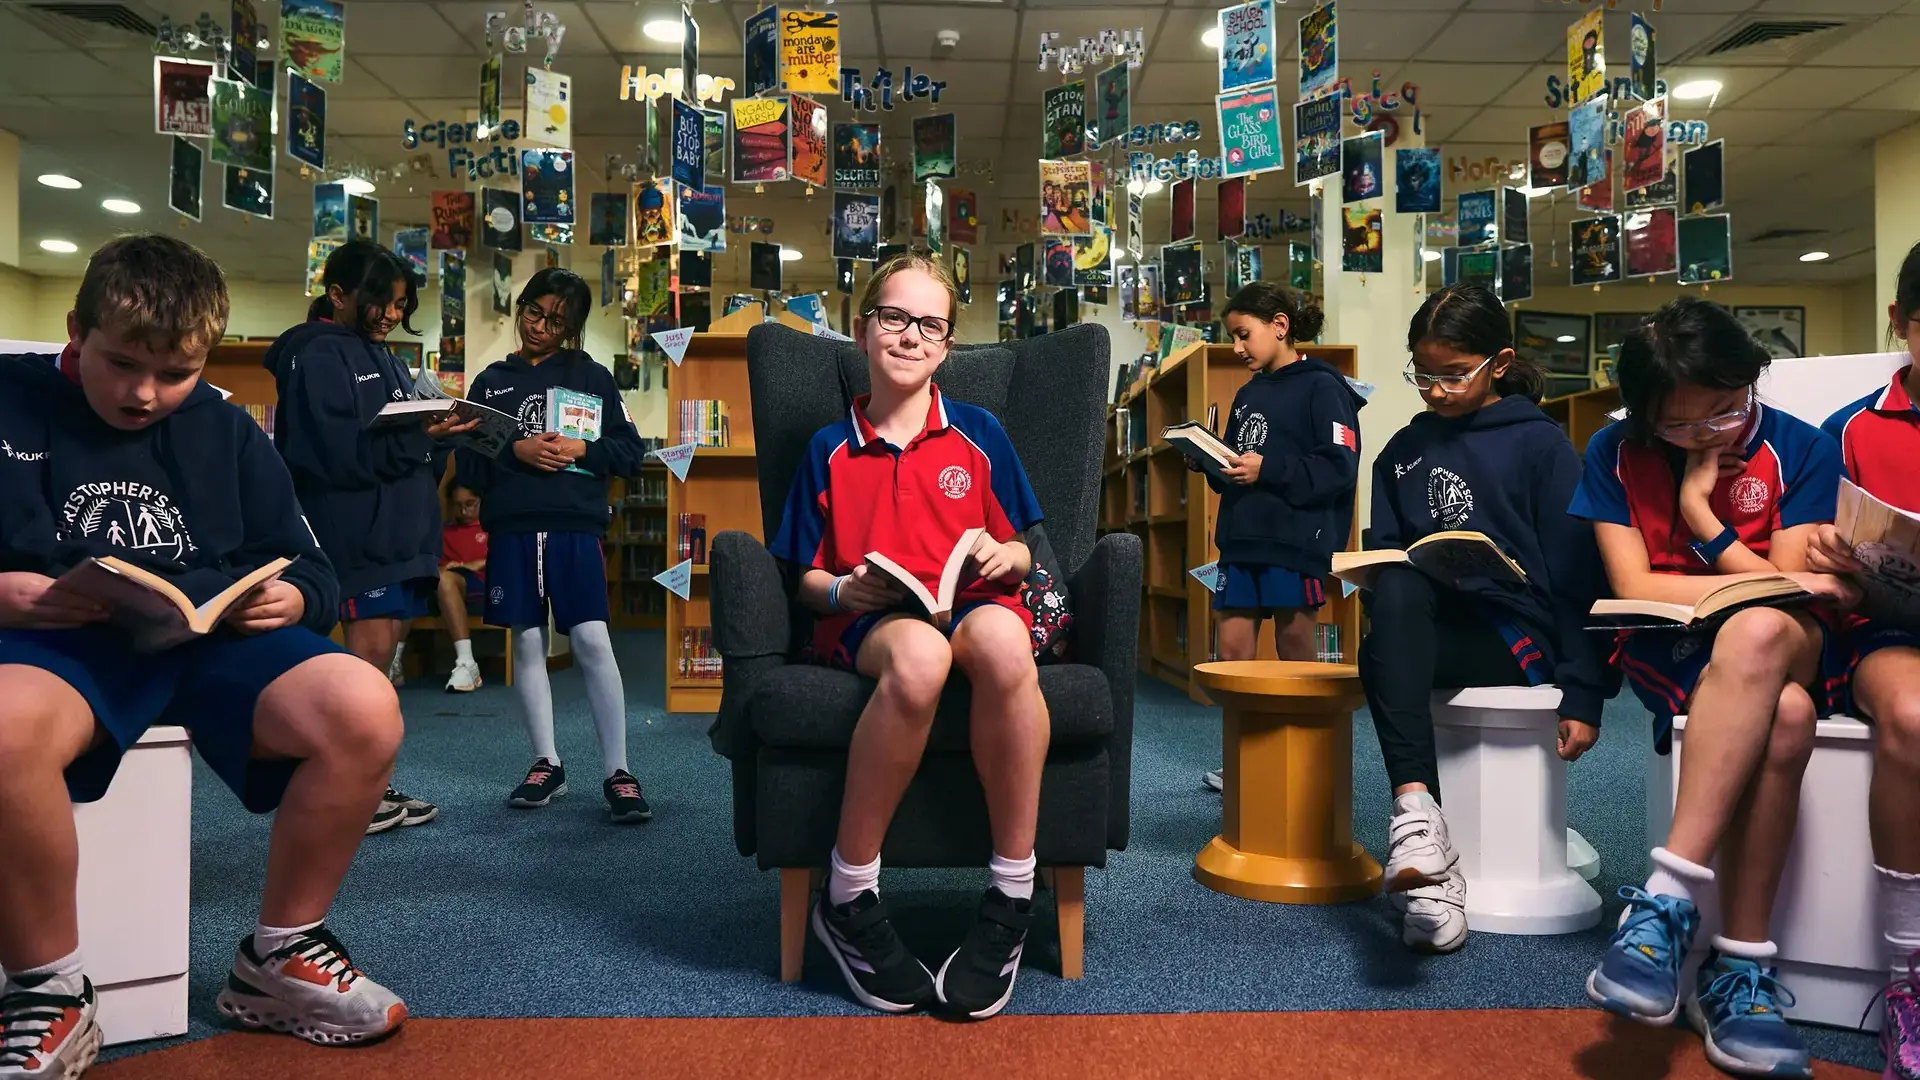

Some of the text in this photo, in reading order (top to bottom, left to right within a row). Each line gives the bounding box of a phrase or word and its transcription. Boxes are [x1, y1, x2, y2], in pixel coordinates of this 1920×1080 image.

[1226, 19, 1267, 36] SCHOOL
[796, 45, 816, 55] are
[1037, 28, 1145, 73] Funny
[788, 51, 838, 67] murder
[620, 65, 736, 102] Horor
[736, 100, 776, 117] NGAIO
[1046, 91, 1084, 110] ACTION
[737, 112, 776, 128] MARSH
[1047, 103, 1082, 127] STAN
[1236, 112, 1254, 126] The
[402, 118, 520, 149] Sciene
[680, 115, 698, 137] BUS
[705, 126, 722, 135] cula
[1227, 122, 1262, 139] GLASS
[677, 130, 700, 152] STOP
[1085, 120, 1201, 150] Sence
[1241, 134, 1268, 149] BIRD
[676, 145, 701, 168] BABY
[1249, 144, 1275, 160] GIRL
[448, 145, 520, 182] Ficti
[1127, 149, 1222, 182] Fictio
[835, 168, 880, 181] SECRET
[850, 203, 868, 214] BOY
[846, 214, 873, 226] FLEW
[664, 340, 686, 349] Grace
[665, 333, 684, 342] Just
[493, 387, 514, 396] KUKRI
[517, 393, 547, 421] CHRISTOPH
[16, 451, 51, 461] KUK
[1427, 466, 1474, 519] ST CHRISTOPHER'S SCH
[56, 481, 169, 542] RISTOPHER'S
[1441, 512, 1469, 530] AHRAIN
